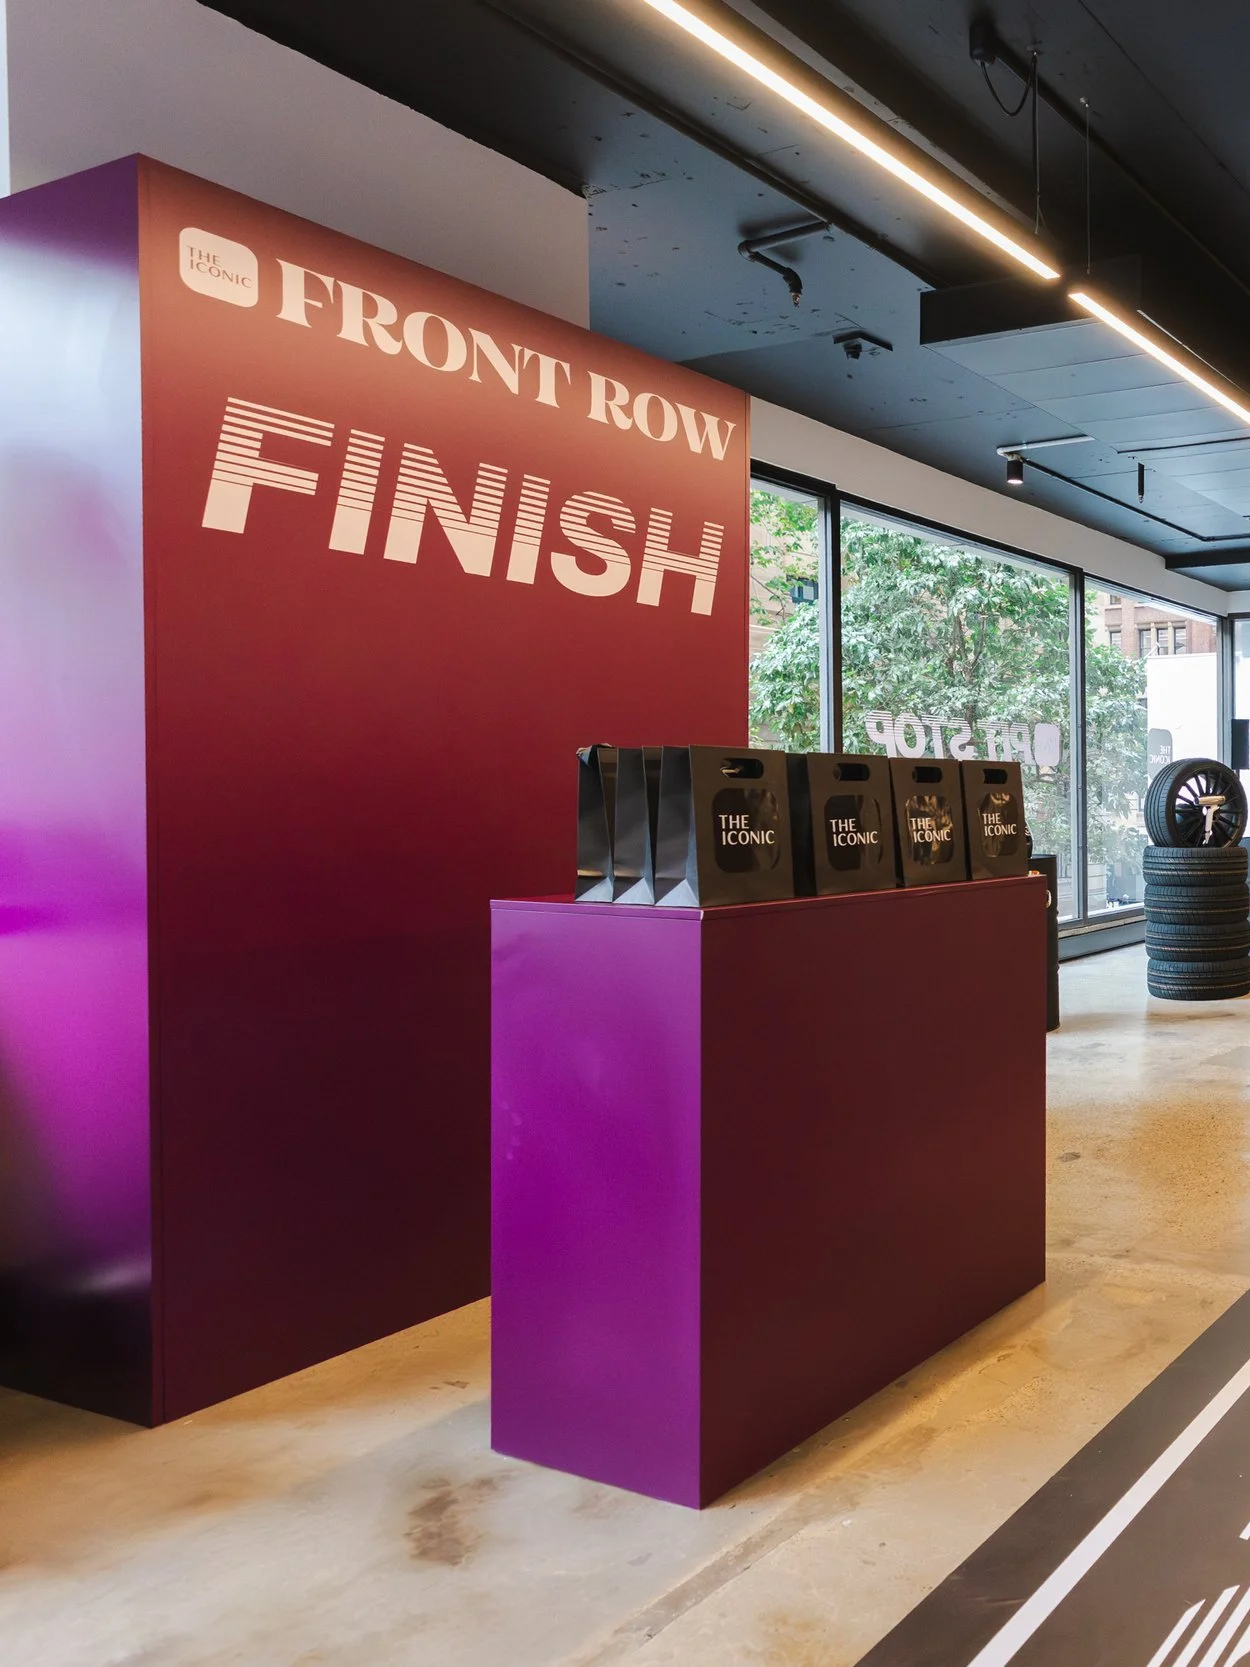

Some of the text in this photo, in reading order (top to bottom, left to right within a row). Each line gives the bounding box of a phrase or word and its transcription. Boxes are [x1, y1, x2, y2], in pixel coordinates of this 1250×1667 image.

[186, 245, 221, 266] THE
[189, 258, 252, 289] ICONIC
[275, 258, 737, 461] FRONT ROW
[202, 397, 726, 616] FINISH
[718, 814, 750, 830] THE
[829, 818, 857, 833] THE
[909, 817, 933, 831] THE
[982, 812, 1002, 825] THE
[721, 829, 776, 846] ICONIC
[912, 829, 952, 844] ICONIC
[984, 823, 1018, 837] ICONIC
[832, 830, 879, 847] ICONIC
